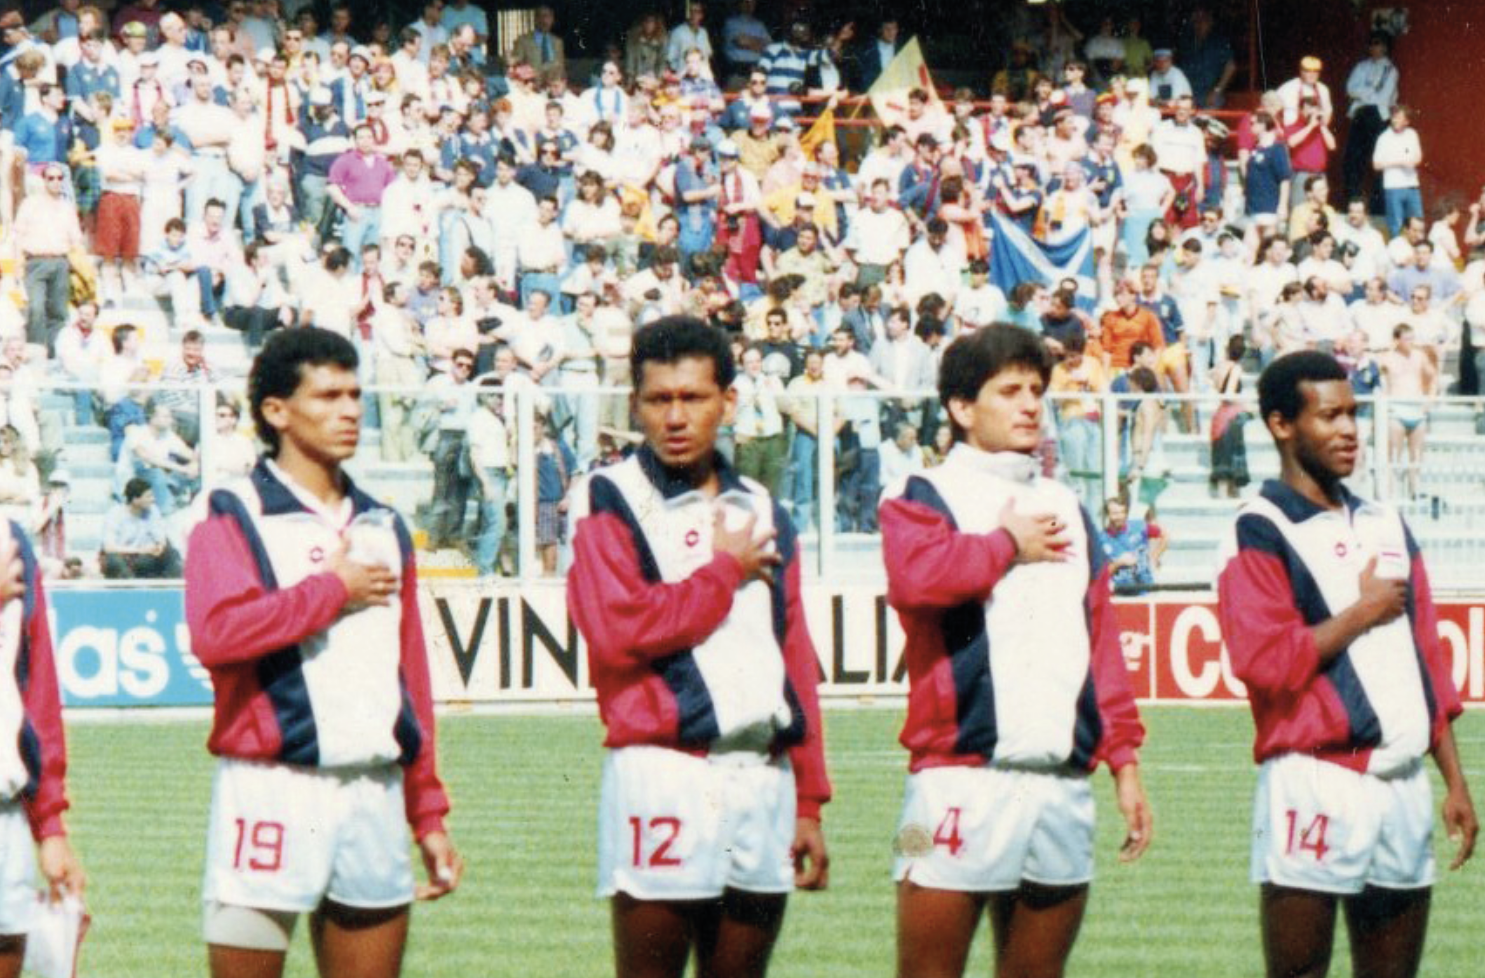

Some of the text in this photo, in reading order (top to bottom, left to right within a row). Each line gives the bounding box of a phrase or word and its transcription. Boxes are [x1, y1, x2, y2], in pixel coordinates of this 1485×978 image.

[52, 607, 170, 699] as
[433, 597, 596, 691] VIN
[818, 594, 908, 685] LI
[234, 818, 285, 872] 19
[628, 815, 682, 868] 12
[932, 806, 964, 856] 4
[1286, 809, 1331, 862] 14
